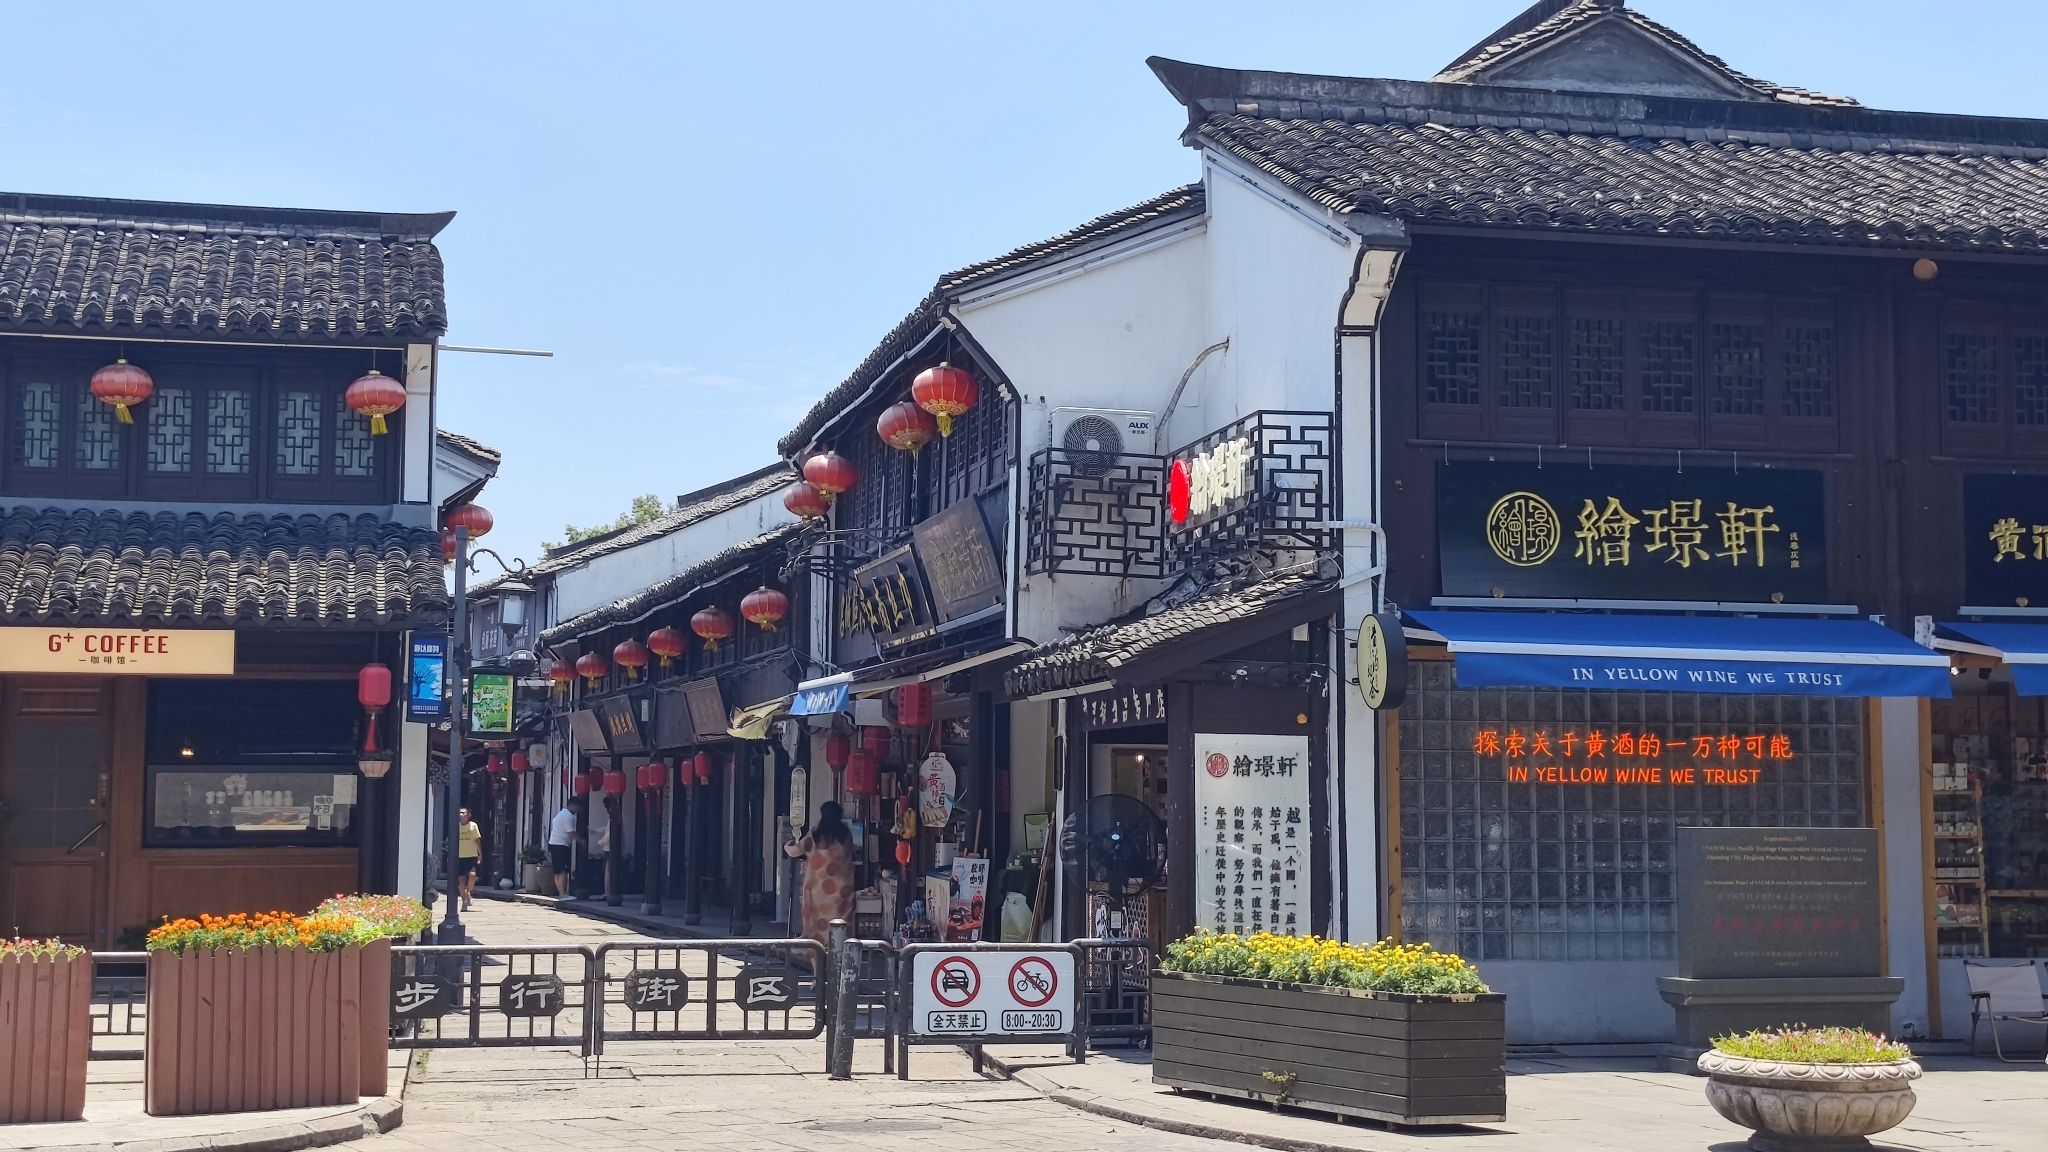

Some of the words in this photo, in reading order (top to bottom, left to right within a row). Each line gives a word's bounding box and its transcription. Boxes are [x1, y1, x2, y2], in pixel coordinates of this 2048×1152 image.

[1574, 496, 1780, 568] 繪璟軒
[84, 635, 169, 654] COFFEE
[90, 656, 126, 665] 咖啡馆
[1572, 668, 1594, 680] IN
[1604, 668, 1678, 681] YELLOW
[1687, 670, 1737, 684] WINE
[1746, 672, 1775, 684] WE
[1785, 672, 1844, 686] TRUST
[1475, 730, 1792, 759] 探索关于黄酒的一万种可能
[1233, 755, 1298, 777] 繪璟軒
[1508, 766, 1527, 782] IN
[1536, 767, 1608, 782] YELLOW
[1615, 767, 1661, 783] WINE
[1670, 768, 1695, 783] WE
[1703, 768, 1761, 784] TRUST
[396, 976, 788, 1013] 步行街区
[933, 1014, 981, 1028] 全天禁止
